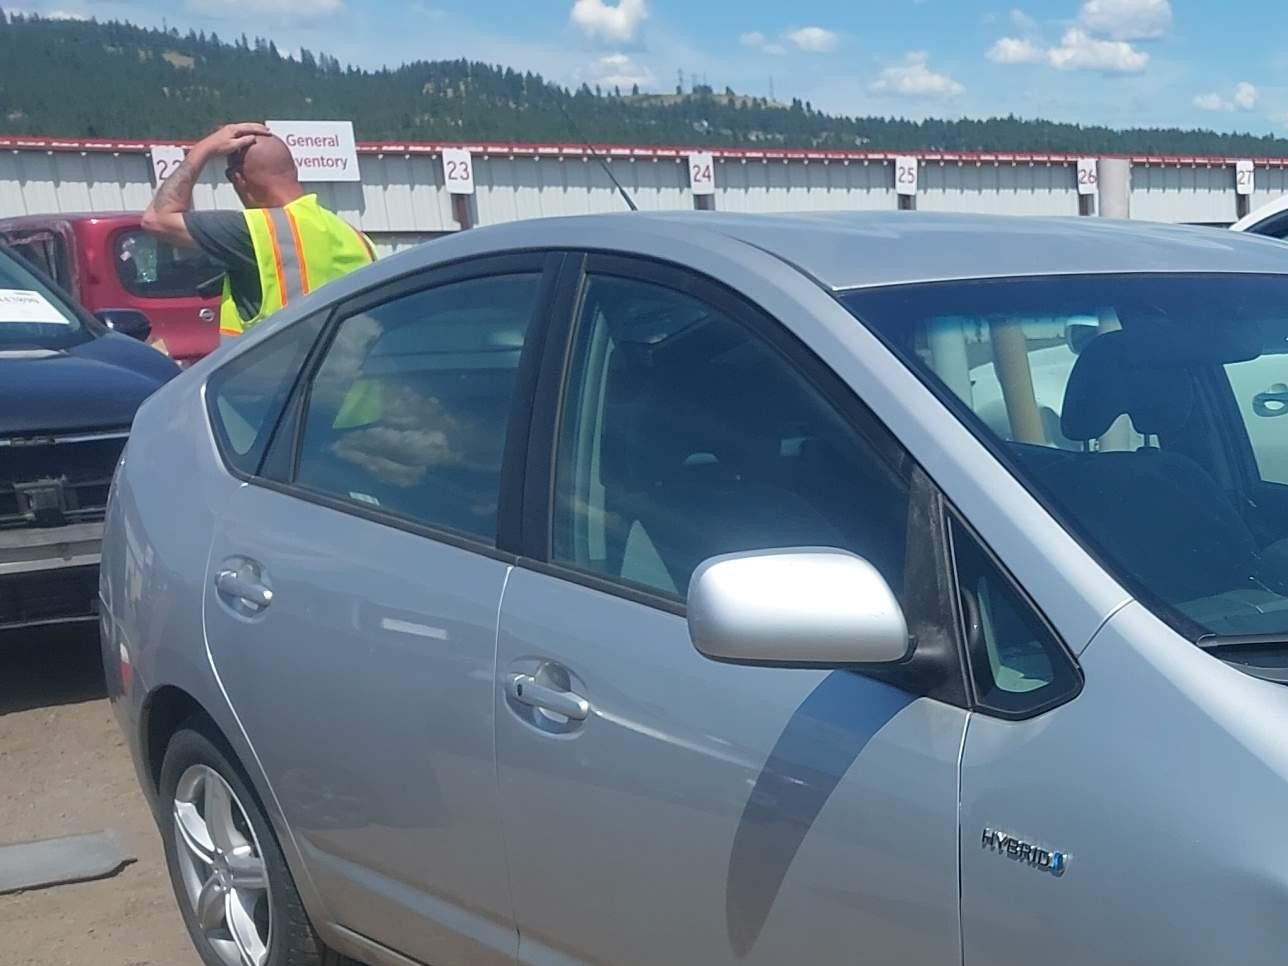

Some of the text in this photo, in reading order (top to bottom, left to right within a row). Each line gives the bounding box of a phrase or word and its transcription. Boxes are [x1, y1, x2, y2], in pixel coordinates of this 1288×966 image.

[287, 134, 340, 148] General
[295, 154, 349, 170] ventory
[447, 160, 471, 181] 23
[692, 164, 712, 183] 24
[897, 166, 916, 184] 25
[1078, 165, 1097, 185] 26
[1237, 169, 1254, 186] 27
[982, 827, 1050, 868] HYBRID
